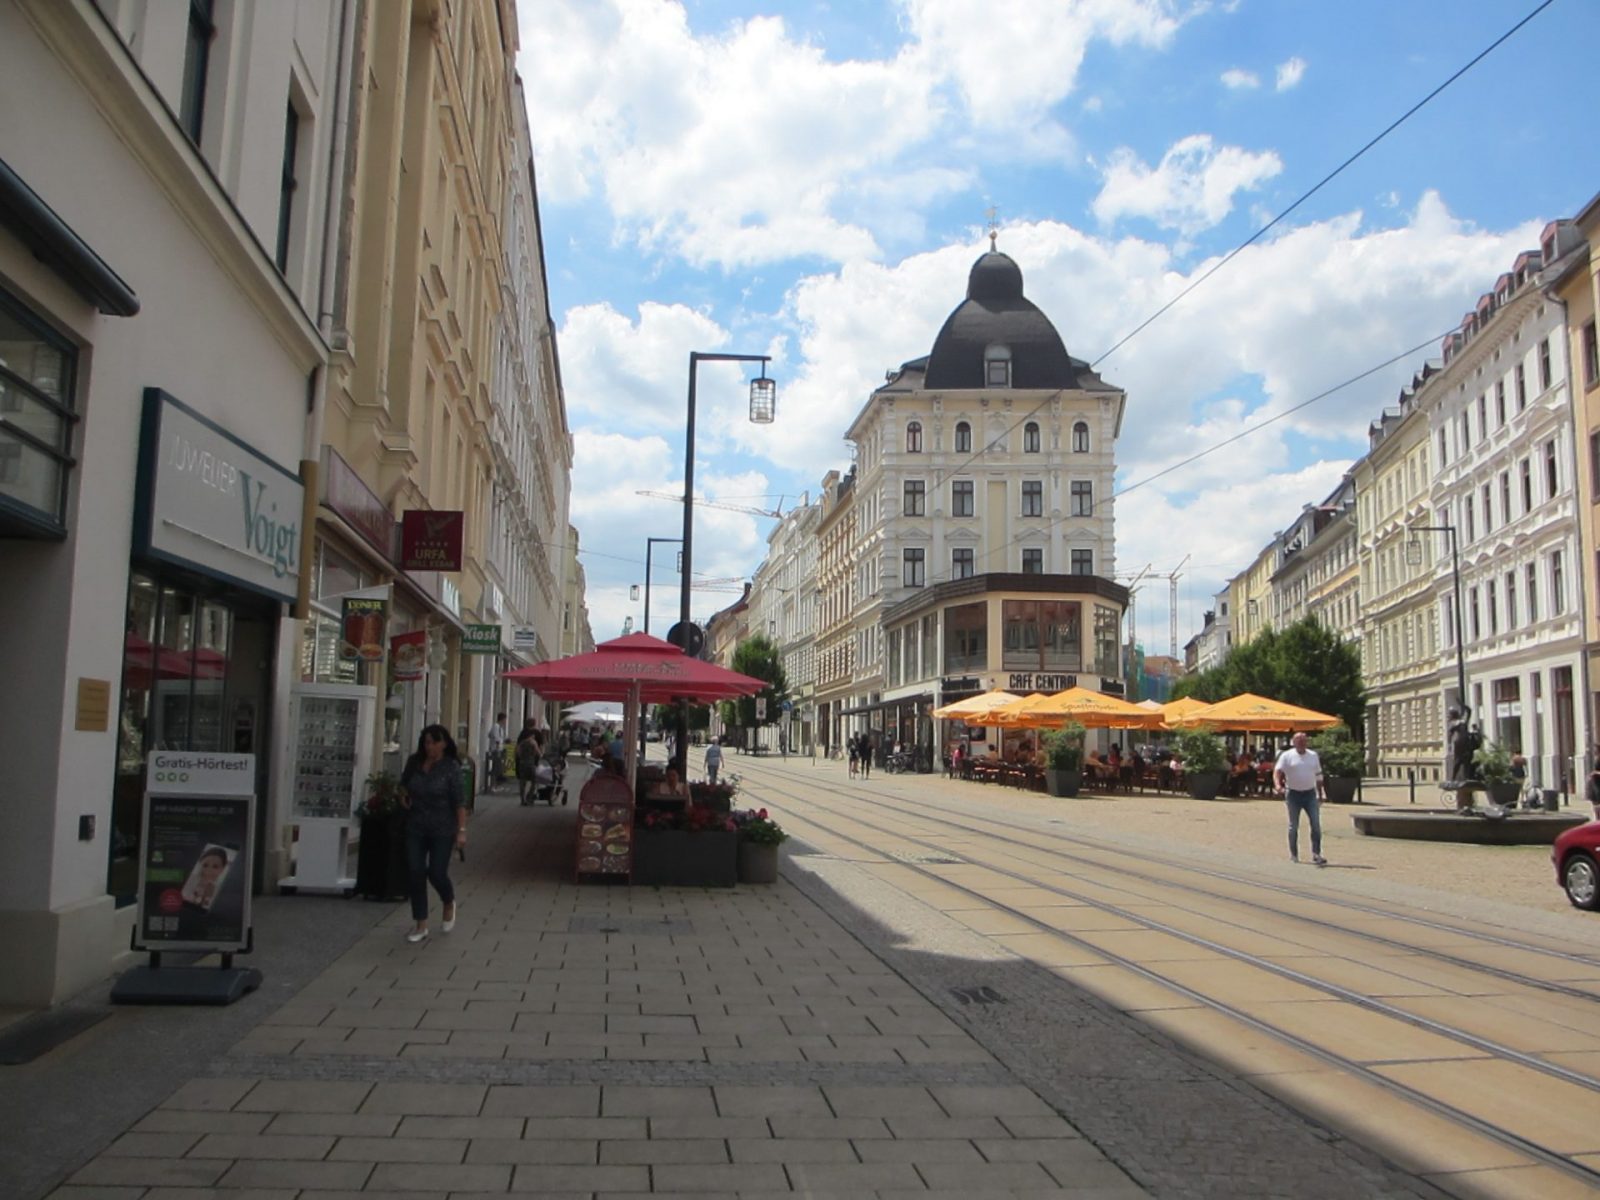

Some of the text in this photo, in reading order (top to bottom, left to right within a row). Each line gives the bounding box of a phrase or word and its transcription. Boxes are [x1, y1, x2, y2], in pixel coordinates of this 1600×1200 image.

[239, 470, 297, 578] Voigt
[415, 549, 447, 560] URFA
[463, 626, 498, 641] Kiosk
[1009, 672, 1033, 689] CAFÉ
[155, 755, 248, 771] Gratis-Hörtest!
